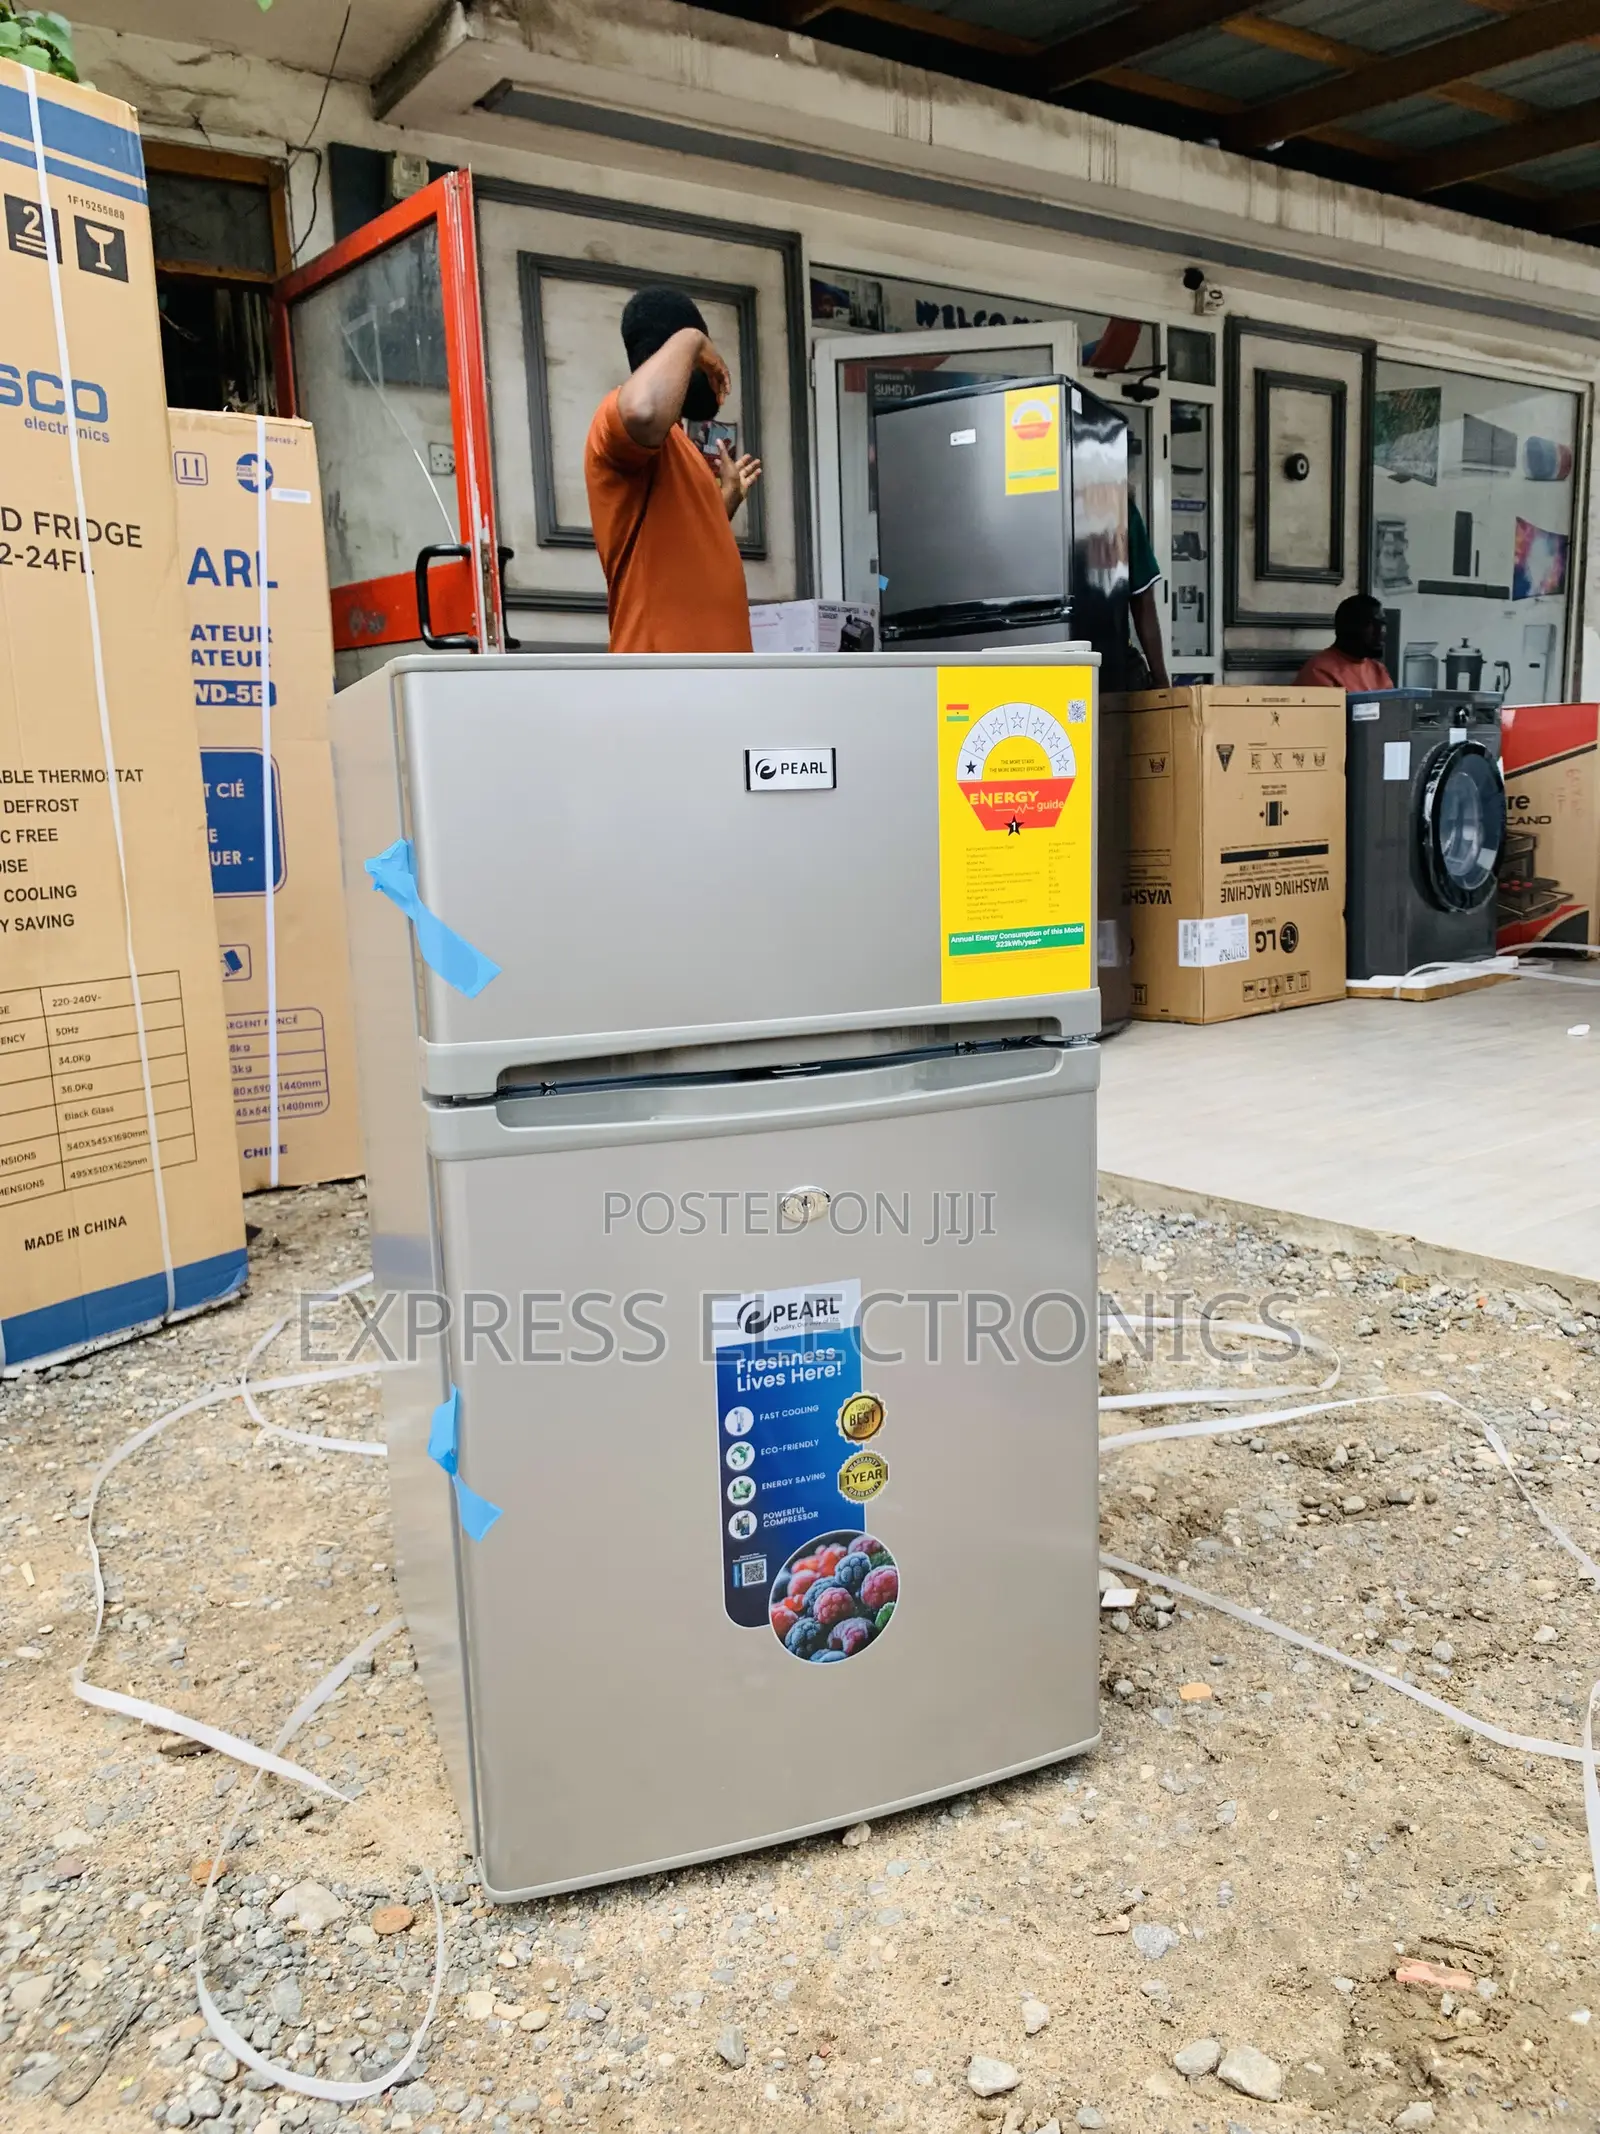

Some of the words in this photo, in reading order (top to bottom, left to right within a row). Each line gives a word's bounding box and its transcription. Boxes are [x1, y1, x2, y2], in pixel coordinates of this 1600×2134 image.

[24, 416, 110, 443] electrnics
[33, 511, 142, 549] FRIDGE
[0, 769, 34, 784] BLE
[38, 768, 143, 783] THERMOTAT
[781, 762, 827, 775] PEARL
[4, 798, 79, 814] DEFROST
[969, 790, 1039, 808] ENERGY
[1037, 798, 1064, 813] guide
[1011, 821, 1017, 831] 1
[16, 828, 59, 843] FREE
[0, 858, 28, 874] ISE
[4, 884, 77, 903] COOLING
[1220, 882, 1271, 904] MACHINE
[1275, 876, 1329, 897] WASHING
[15, 913, 75, 932] SAVING
[951, 935, 974, 944] Annual
[975, 934, 998, 944] Energy
[999, 931, 1042, 941] Consumption
[1064, 925, 1084, 934] Model
[1255, 929, 1277, 952] LG
[227, 1019, 261, 1030] RGENT
[264, 1015, 298, 1027] FNCÉ
[64, 1110, 89, 1122] Black
[91, 1105, 115, 1117] Glass
[24, 1229, 64, 1252] MADE
[67, 1226, 80, 1240] IN
[84, 1214, 128, 1236] CHINA
[773, 1297, 840, 1323] PEARL
[736, 1347, 836, 1375] Freshness
[736, 1372, 786, 1392] Lives
[791, 1361, 842, 1384] Here!
[759, 1411, 780, 1422] FAST
[781, 1404, 820, 1418] COOLING
[849, 1409, 876, 1427] BEST
[760, 1439, 820, 1456] ECO-FRIENDLY
[761, 1478, 793, 1490] ENERGY
[795, 1472, 826, 1485] SAVING
[844, 1474, 850, 1485] 1
[852, 1468, 883, 1484] YEAR
[763, 1506, 806, 1520] POWERFUL
[763, 1510, 819, 1528] COMPRESSOR
